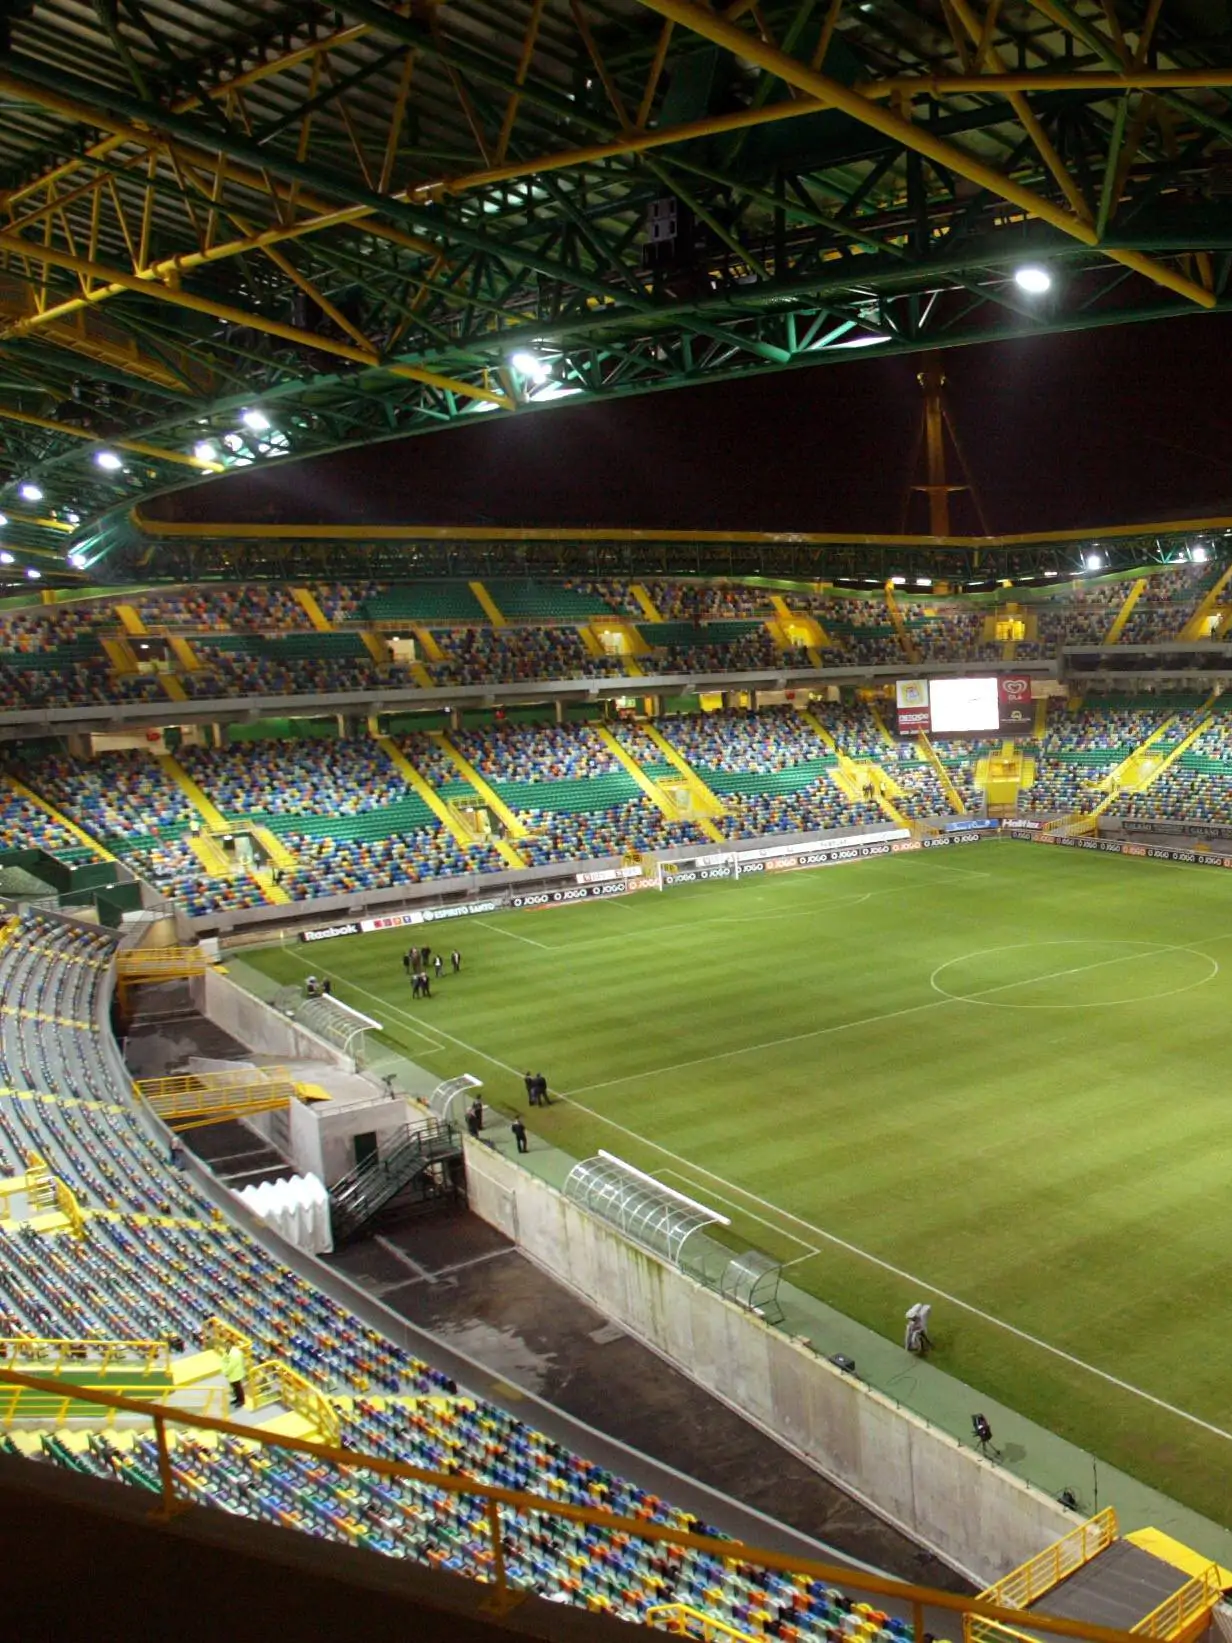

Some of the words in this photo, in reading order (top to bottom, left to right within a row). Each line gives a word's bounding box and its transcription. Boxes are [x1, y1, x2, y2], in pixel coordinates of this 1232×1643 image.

[870, 846, 889, 854] JOGO
[900, 842, 921, 850] JOGO
[807, 854, 827, 863] JOGO
[743, 863, 763, 872] JOGO
[776, 859, 796, 868] JOGO
[709, 868, 730, 877] JOGO
[667, 876, 673, 884] O
[675, 873, 696, 882] JOGO
[602, 884, 624, 894] JOGO
[629, 882, 636, 890] O
[639, 879, 660, 888] JOGO
[564, 888, 587, 900] JOGO
[524, 895, 548, 905] JOGO
[305, 924, 358, 940] Reebok
